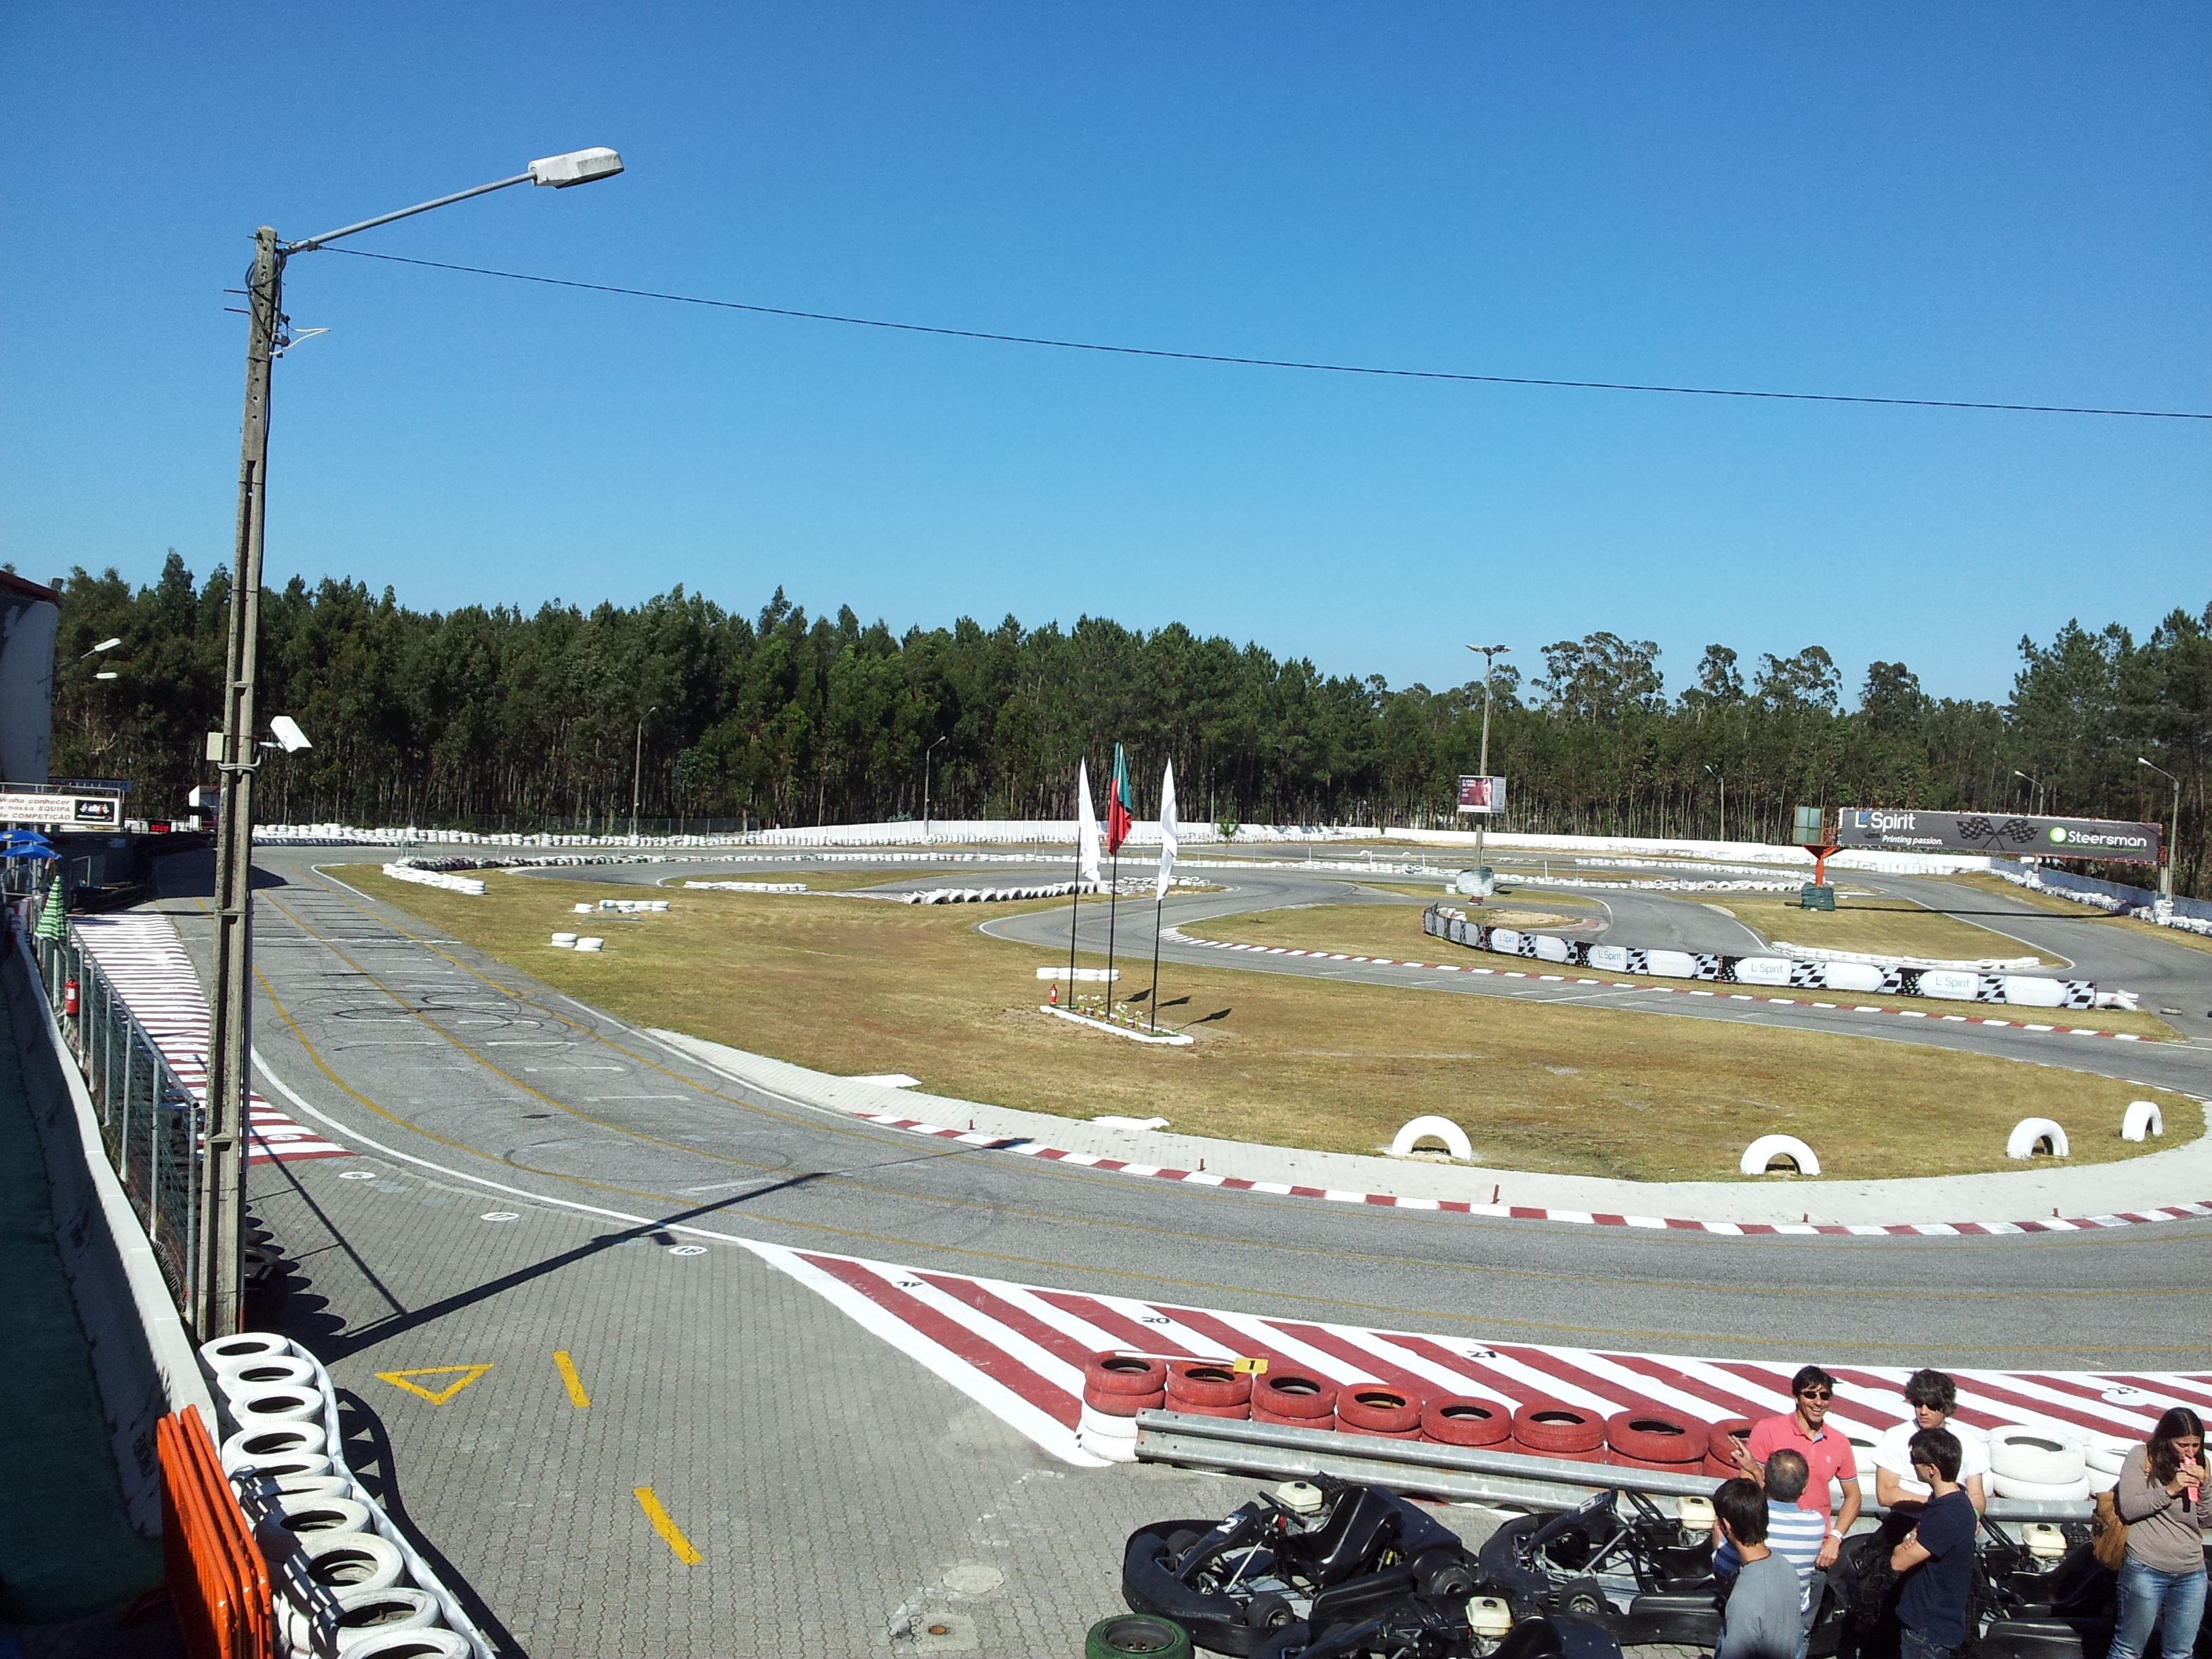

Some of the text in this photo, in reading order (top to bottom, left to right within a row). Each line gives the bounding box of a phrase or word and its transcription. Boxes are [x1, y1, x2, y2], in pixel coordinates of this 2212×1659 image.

[1870, 812, 1916, 832] Spirit
[1881, 834, 1944, 846] Printing passion.
[2068, 830, 2147, 847] Steersman
[1604, 950, 1622, 961] Spirit
[1759, 963, 1784, 975] Spirit
[1945, 977, 1970, 989] Spirit
[1141, 1316, 1170, 1324] 20
[1467, 1350, 1497, 1358] 21
[1249, 1359, 1256, 1370] 1
[2106, 1387, 2139, 1395] 23
[1216, 1517, 1238, 1533] 2
